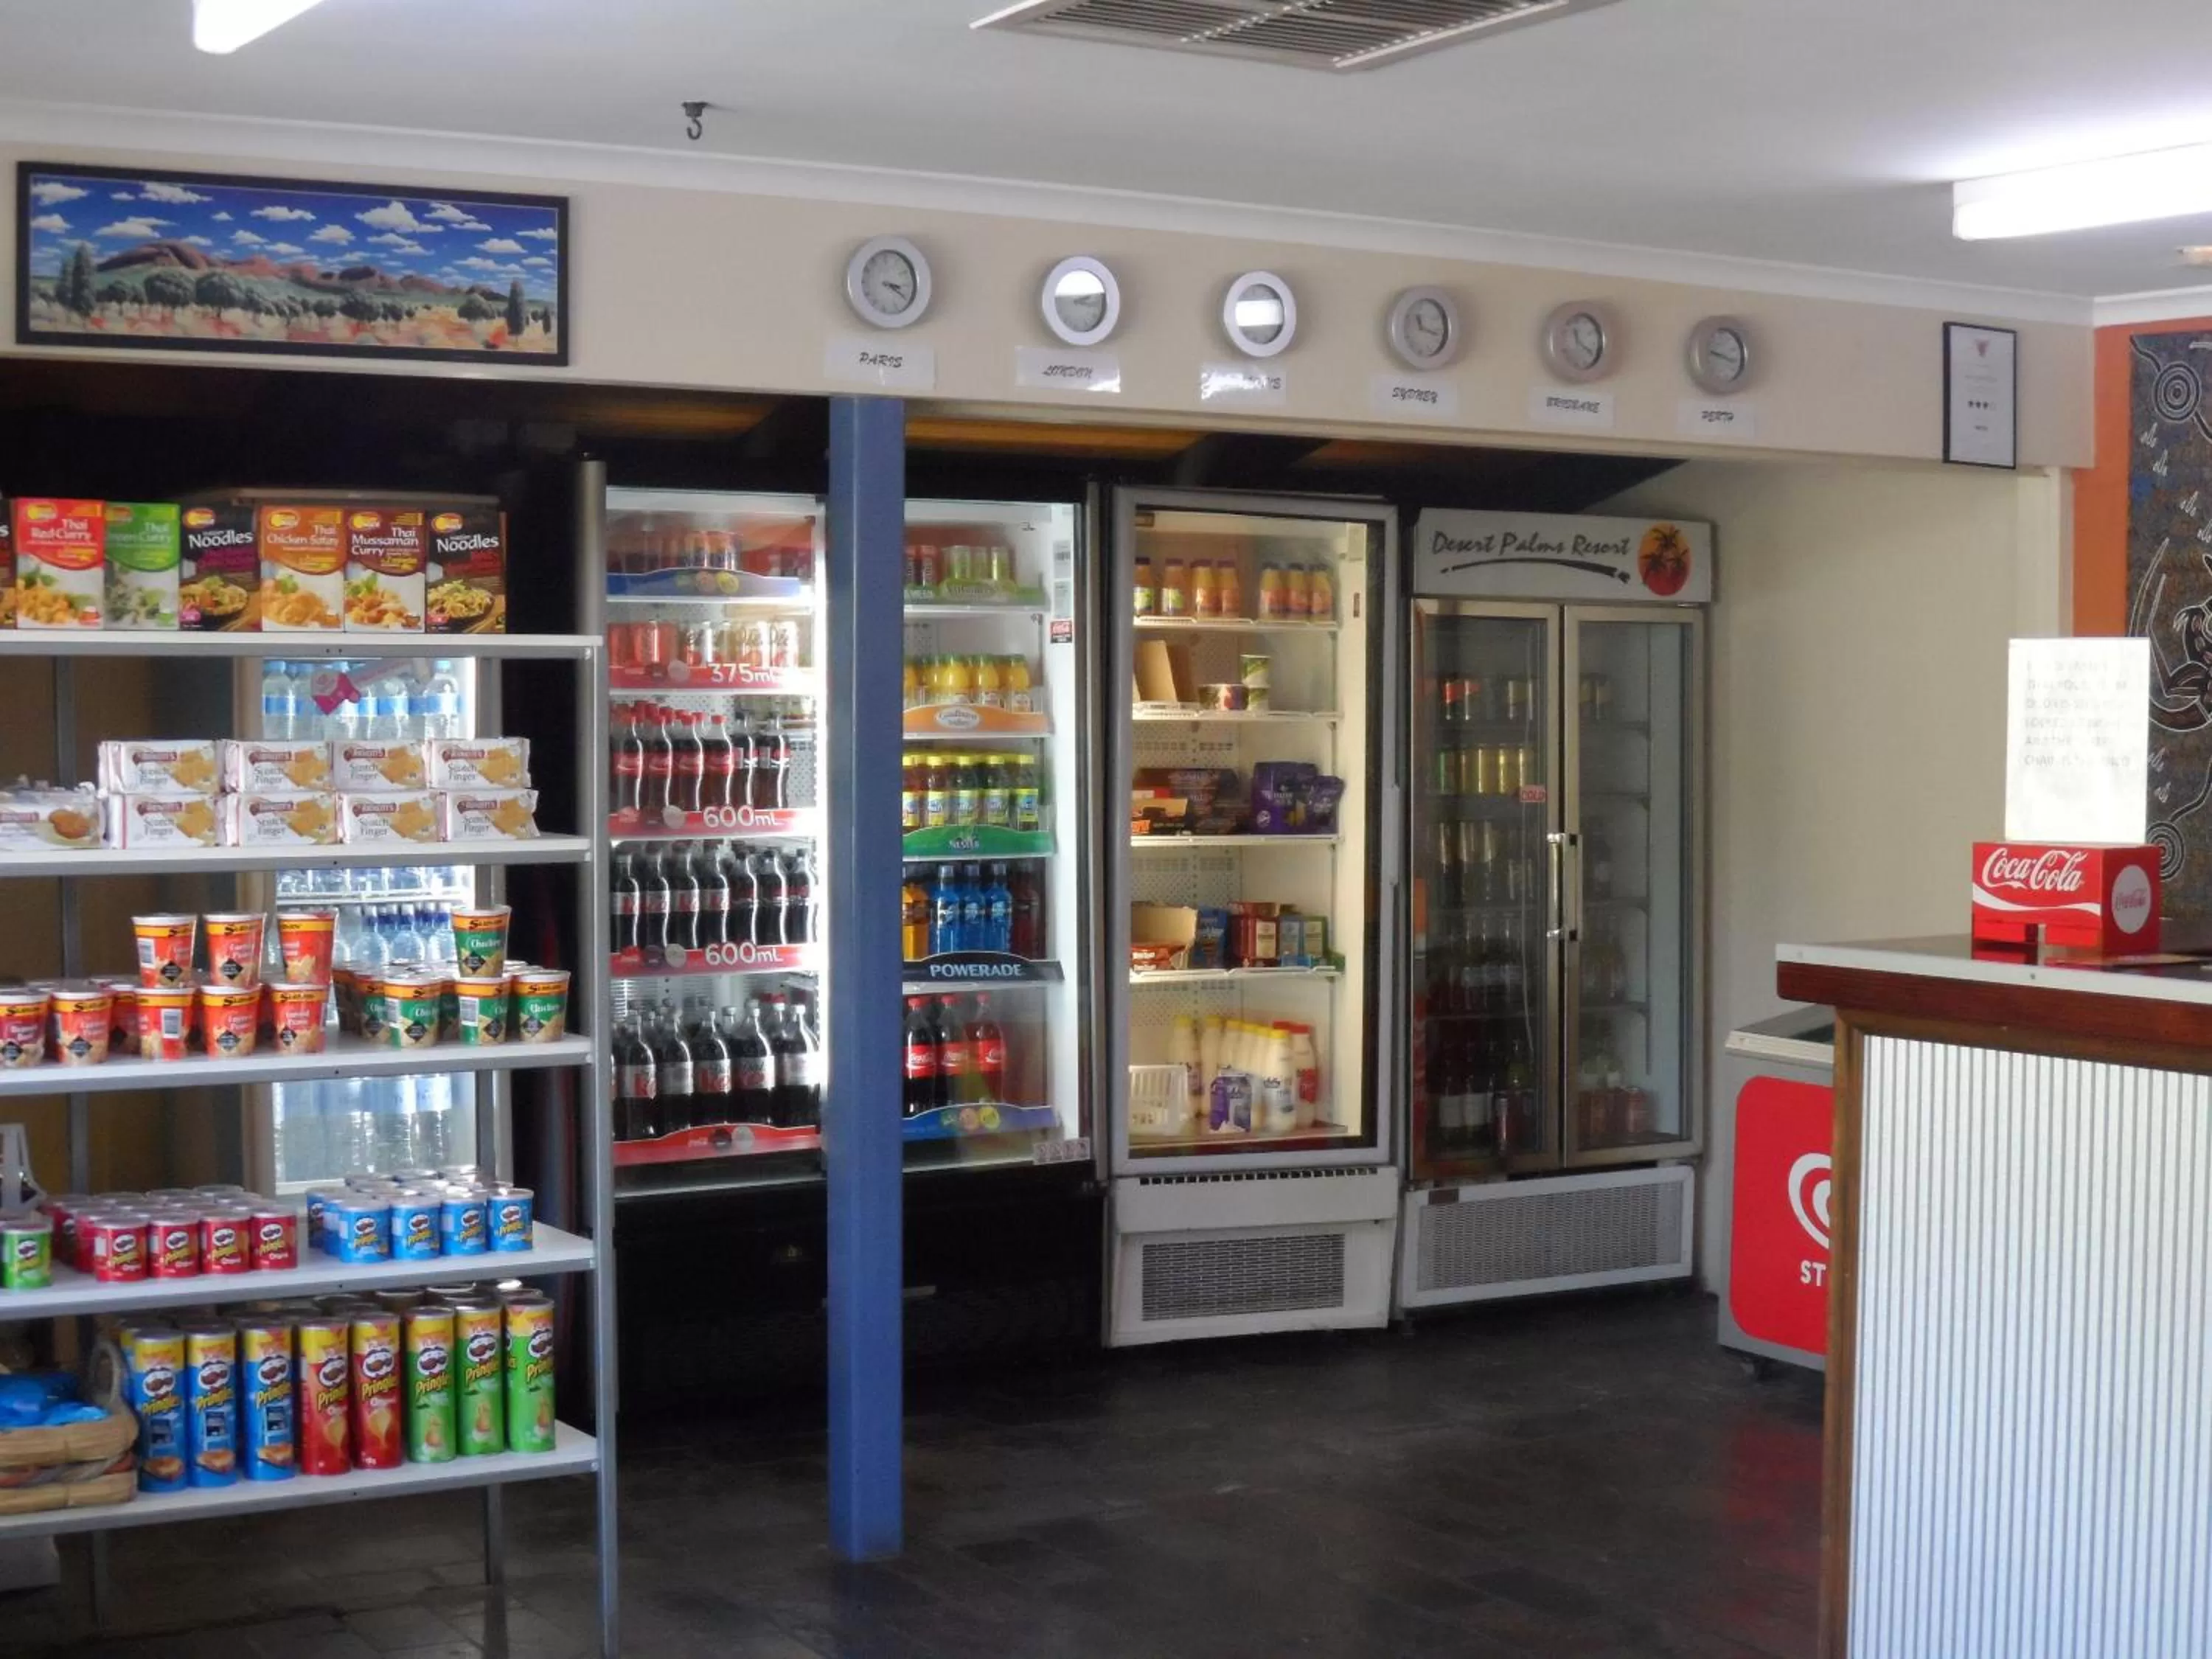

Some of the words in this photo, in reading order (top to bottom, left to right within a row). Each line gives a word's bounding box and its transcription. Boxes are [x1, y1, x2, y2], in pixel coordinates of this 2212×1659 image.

[859, 352, 903, 368] PARIS
[188, 529, 254, 549] Noodles
[391, 526, 417, 538] Thai
[351, 545, 385, 557] Curry
[436, 533, 500, 553] Noodles
[1432, 529, 1495, 554] Desert
[1499, 531, 1565, 556] Palms
[1571, 533, 1631, 556] Resort
[703, 805, 782, 828] 600mL
[1981, 847, 2089, 892] Coca-Cola
[705, 942, 785, 966] 600mL
[929, 963, 1023, 978] POWERADE
[1800, 1259, 1828, 1287] ST
